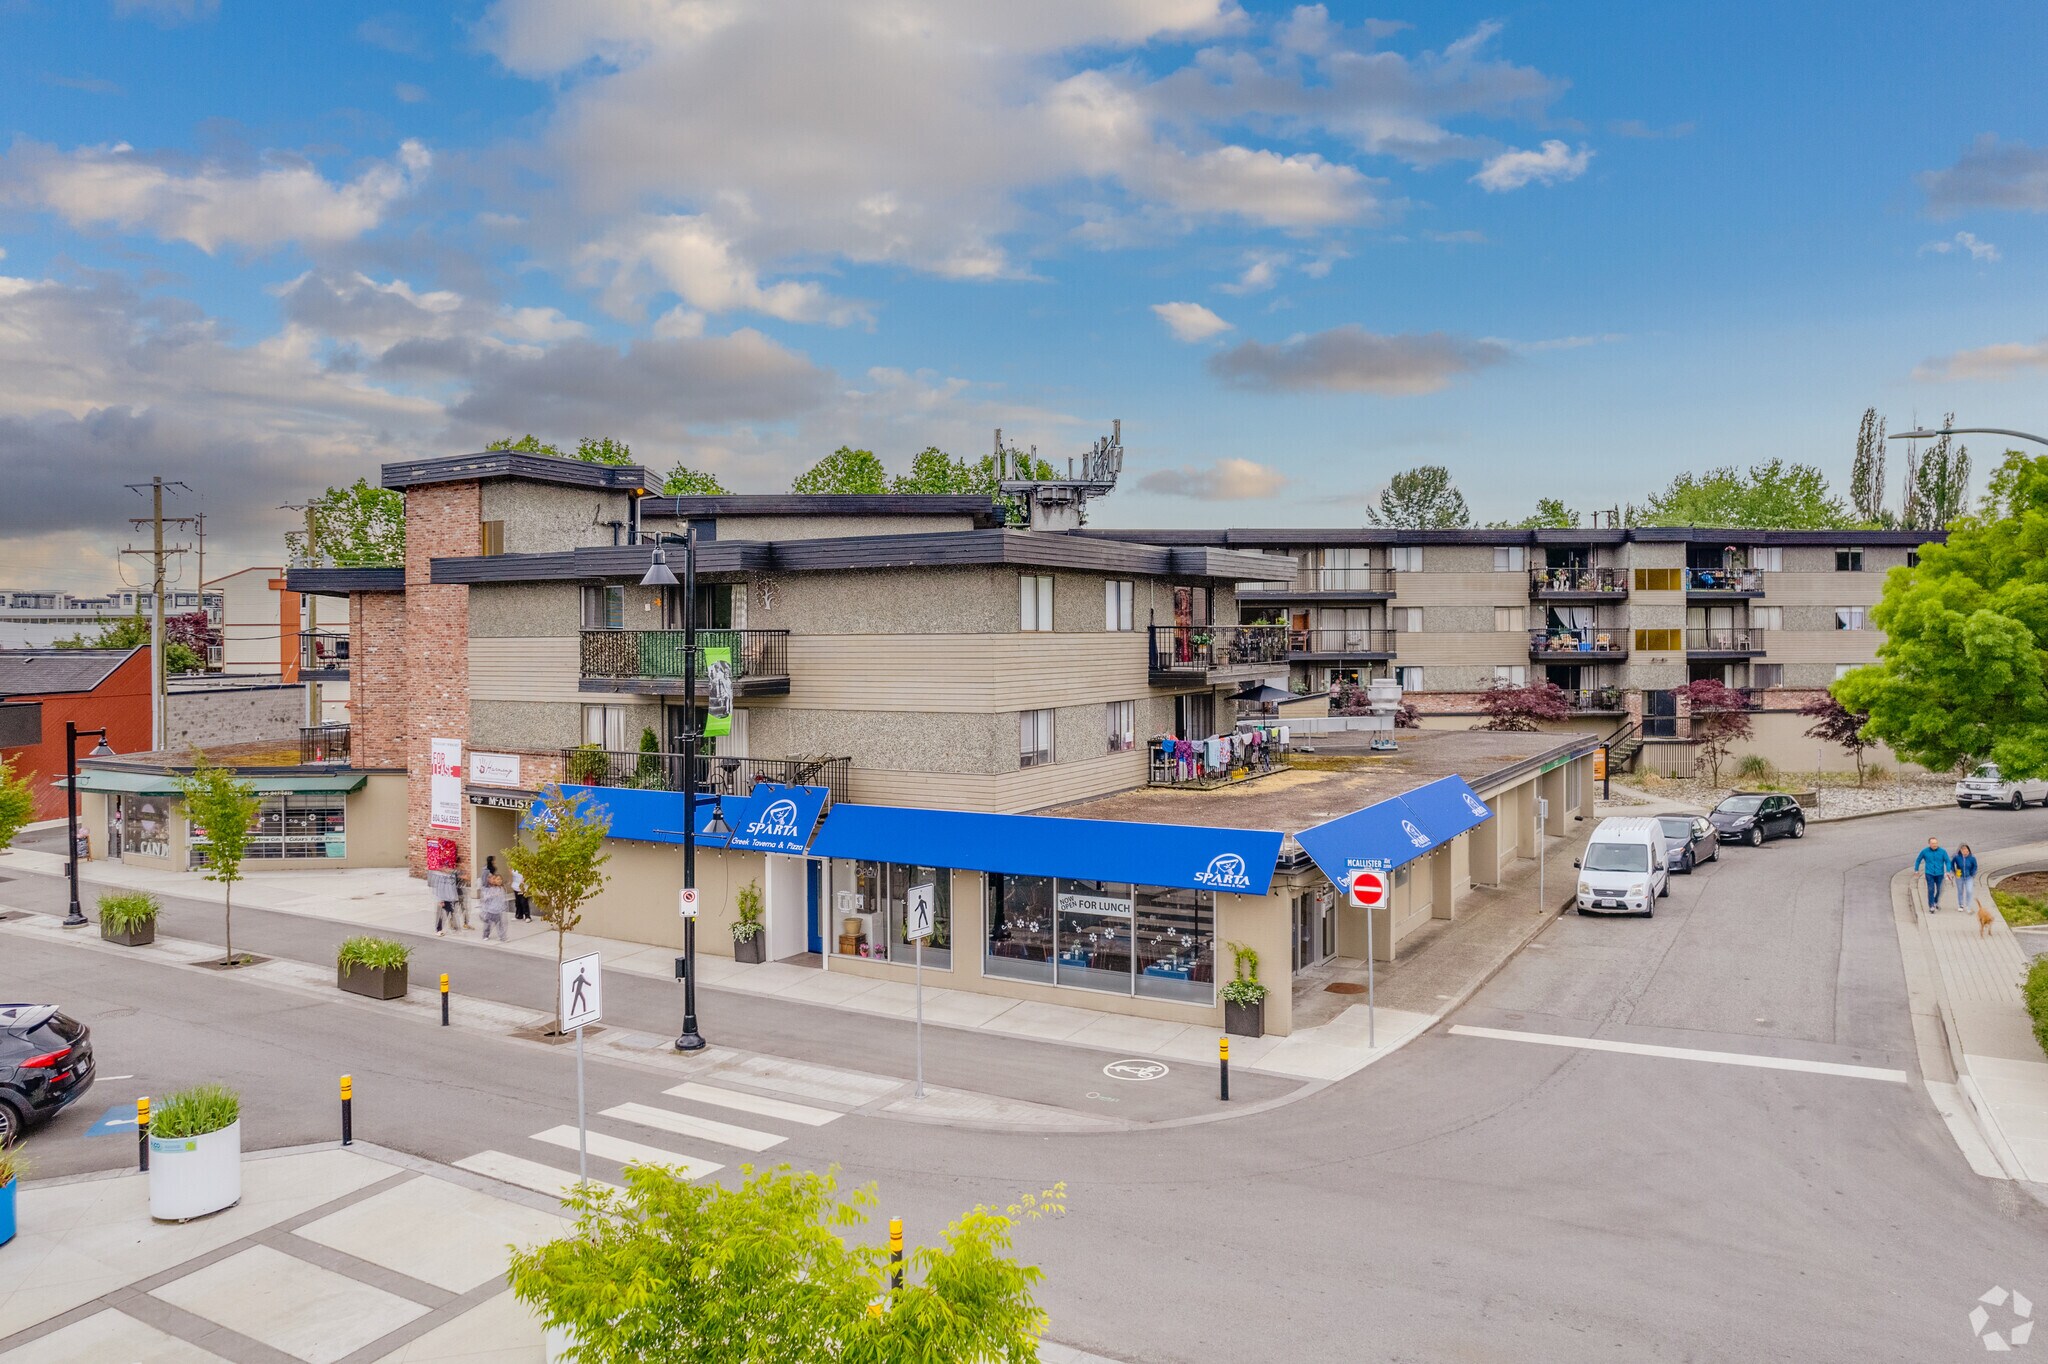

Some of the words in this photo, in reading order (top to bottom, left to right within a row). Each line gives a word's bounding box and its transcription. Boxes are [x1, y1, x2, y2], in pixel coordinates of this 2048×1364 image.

[433, 752, 446, 764] FOR
[432, 764, 454, 777] LEASE
[746, 822, 798, 837] SPARTA
[731, 837, 750, 846] Greek
[752, 838, 777, 848] Taverna
[778, 841, 784, 849] &
[786, 841, 804, 851] Pizza
[1347, 859, 1382, 868] MCALLISTER
[855, 867, 878, 878] OPEN
[1194, 872, 1250, 886] SPARTA
[1059, 896, 1075, 905] NOW
[1060, 900, 1078, 911] OPEN
[1079, 900, 1097, 910] FOR
[1099, 901, 1131, 913] LUNCH
